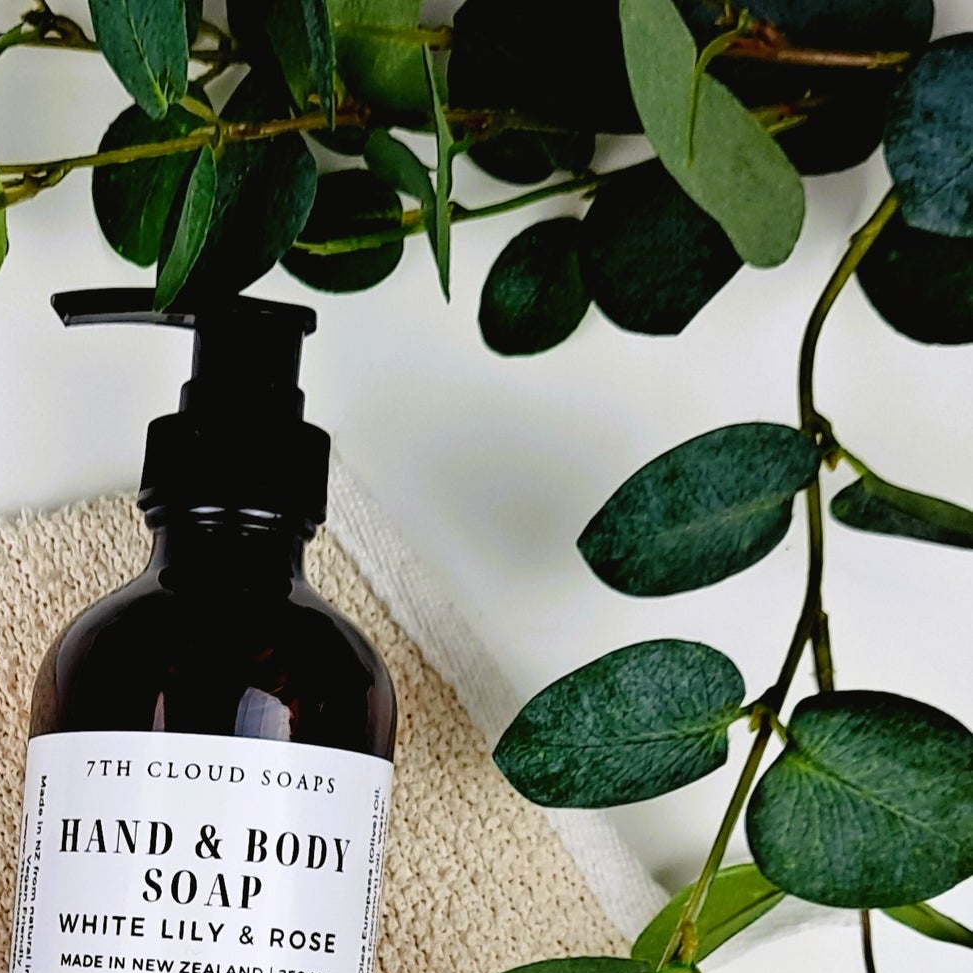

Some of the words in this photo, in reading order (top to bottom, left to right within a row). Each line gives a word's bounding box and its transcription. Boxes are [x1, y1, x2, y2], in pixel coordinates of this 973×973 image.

[38, 774, 47, 816] Made
[86, 759, 132, 777] 7TH
[147, 761, 245, 783] CLOUD
[261, 770, 335, 794] SOAPS
[37, 820, 43, 835] in
[58, 818, 173, 856] HAND
[194, 824, 222, 860] &
[245, 828, 351, 873] BODY
[35, 839, 42, 860] NZ
[31, 865, 39, 901] from
[142, 868, 262, 910] SOAP
[26, 905, 35, 959] natural
[58, 912, 146, 937] WHITE
[161, 918, 225, 943] LILY
[238, 925, 254, 946] &
[269, 927, 336, 954] ROSE
[60, 953, 104, 969] MADE
[108, 955, 126, 970] IN
[132, 957, 175, 973] NEW
